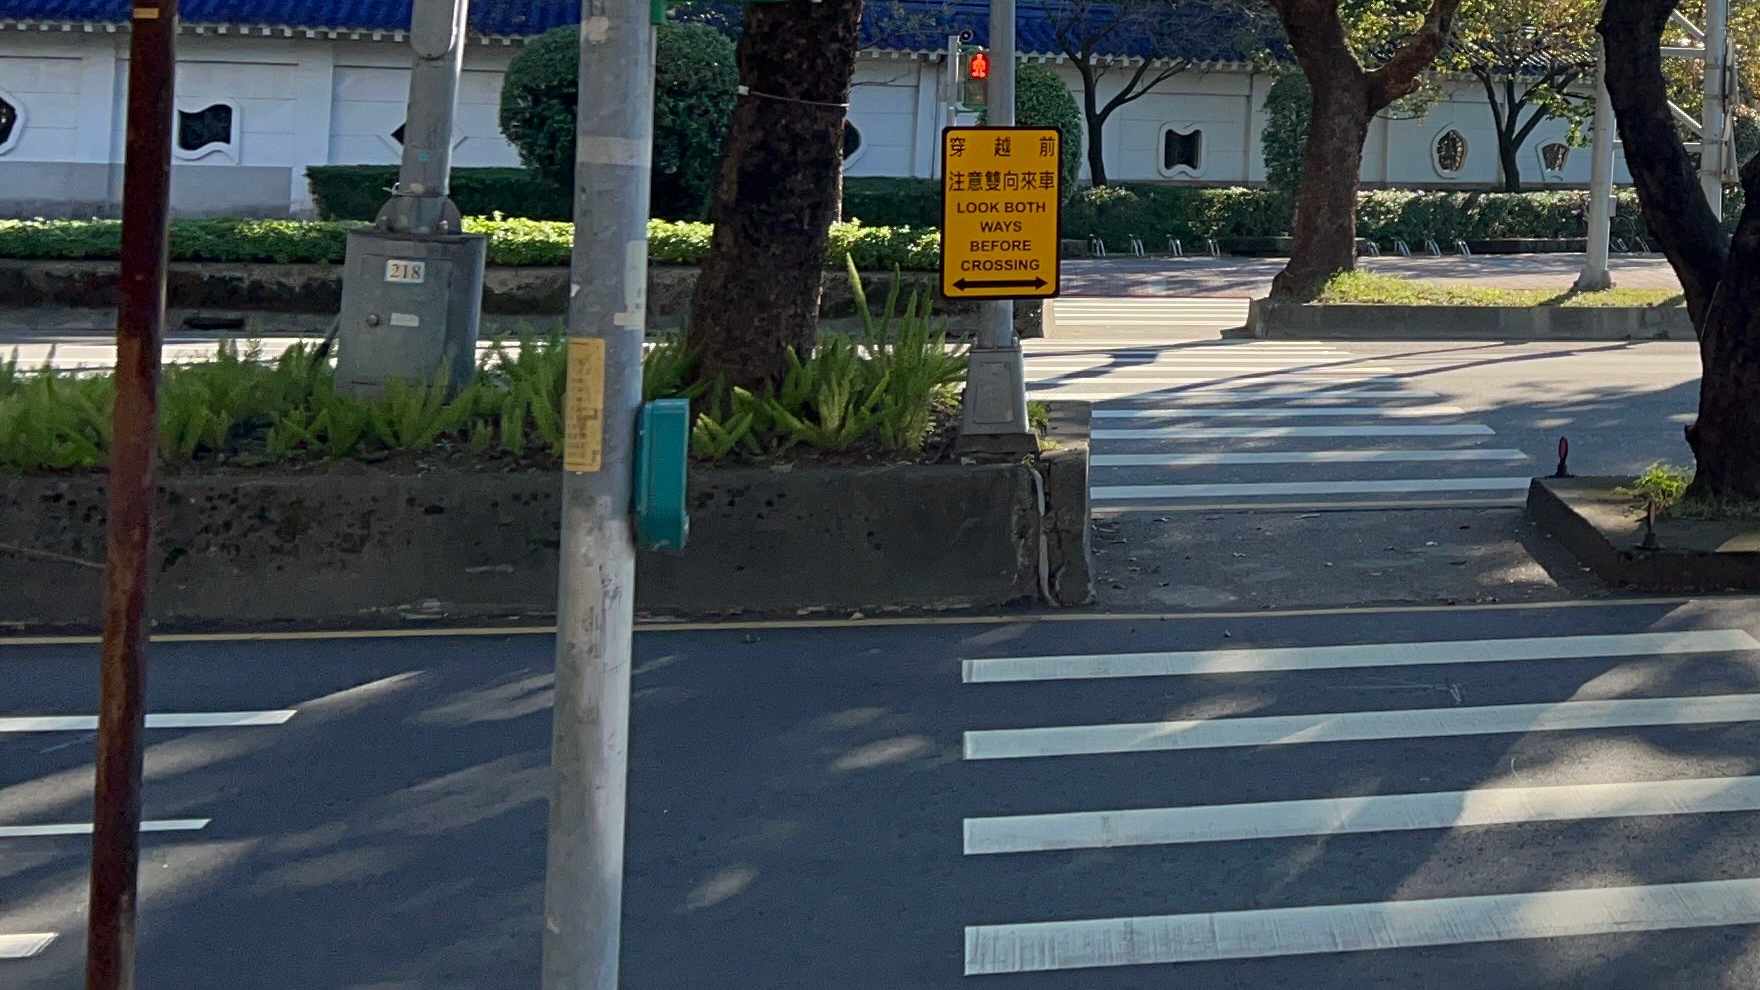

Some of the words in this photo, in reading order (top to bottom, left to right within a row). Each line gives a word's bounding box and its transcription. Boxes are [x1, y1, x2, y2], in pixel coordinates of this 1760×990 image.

[949, 137, 1055, 157] 穿越前
[949, 171, 1055, 191] 注意雙向來車
[957, 202, 999, 214] LOOK
[1004, 202, 1046, 213] BOTH
[980, 221, 1023, 233] WAYS
[970, 240, 1032, 252] BEFORE
[390, 263, 421, 280] 218
[961, 259, 1040, 272] CROSSING
